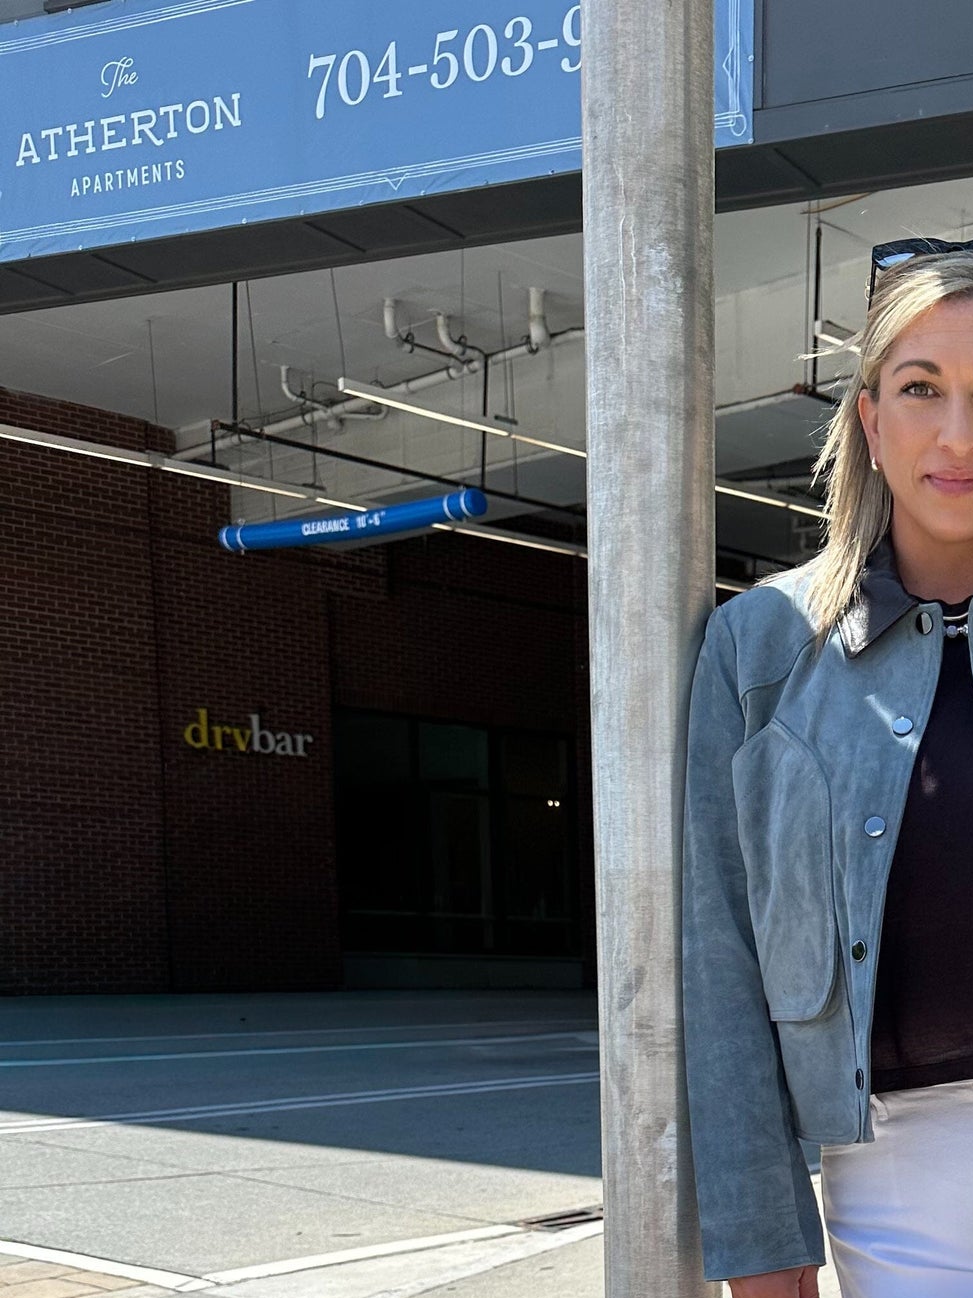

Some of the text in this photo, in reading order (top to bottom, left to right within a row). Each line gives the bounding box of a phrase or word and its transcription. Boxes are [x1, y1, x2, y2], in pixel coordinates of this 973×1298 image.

[101, 56, 138, 98] The
[16, 92, 241, 167] ATHERTON
[70, 159, 185, 197] APARTMENTS
[302, 518, 350, 536] CLEARANCE
